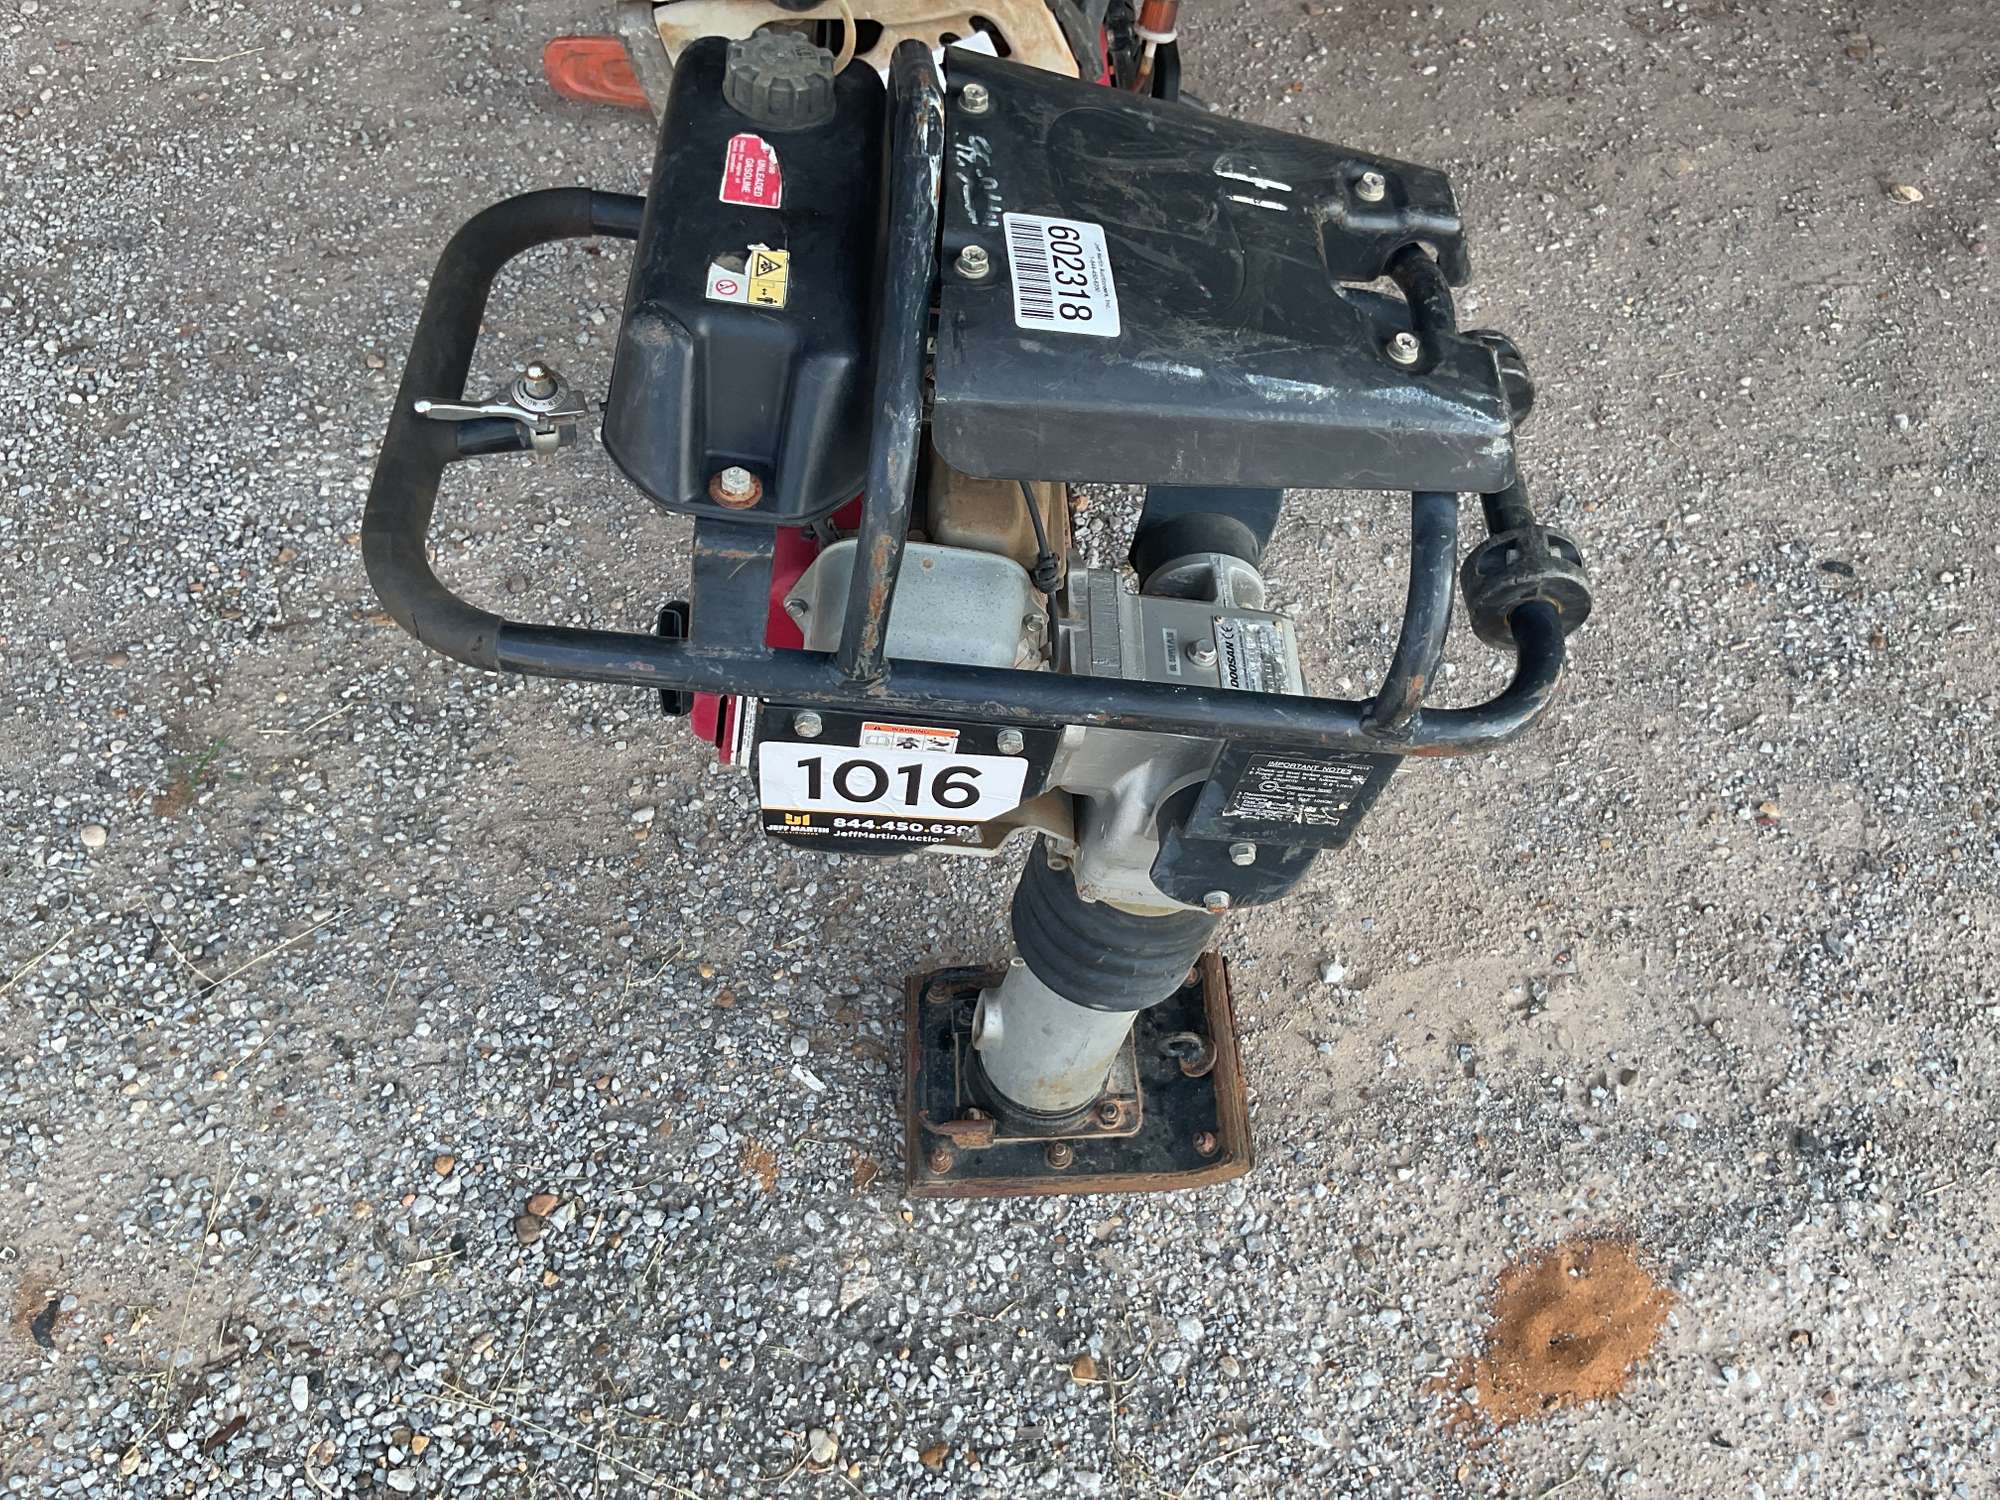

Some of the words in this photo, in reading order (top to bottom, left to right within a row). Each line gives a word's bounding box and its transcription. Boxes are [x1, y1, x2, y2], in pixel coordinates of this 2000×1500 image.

[741, 158, 754, 193] GASOLINE
[753, 159, 767, 197] UNLEADED
[1047, 225, 1092, 321] 602318
[1226, 641, 1239, 688] DOOSAN
[797, 756, 982, 809] 1016
[1267, 760, 1320, 771] IMPORTANT
[1321, 766, 1353, 775] NOTES
[833, 817, 973, 836] 844.450.620
